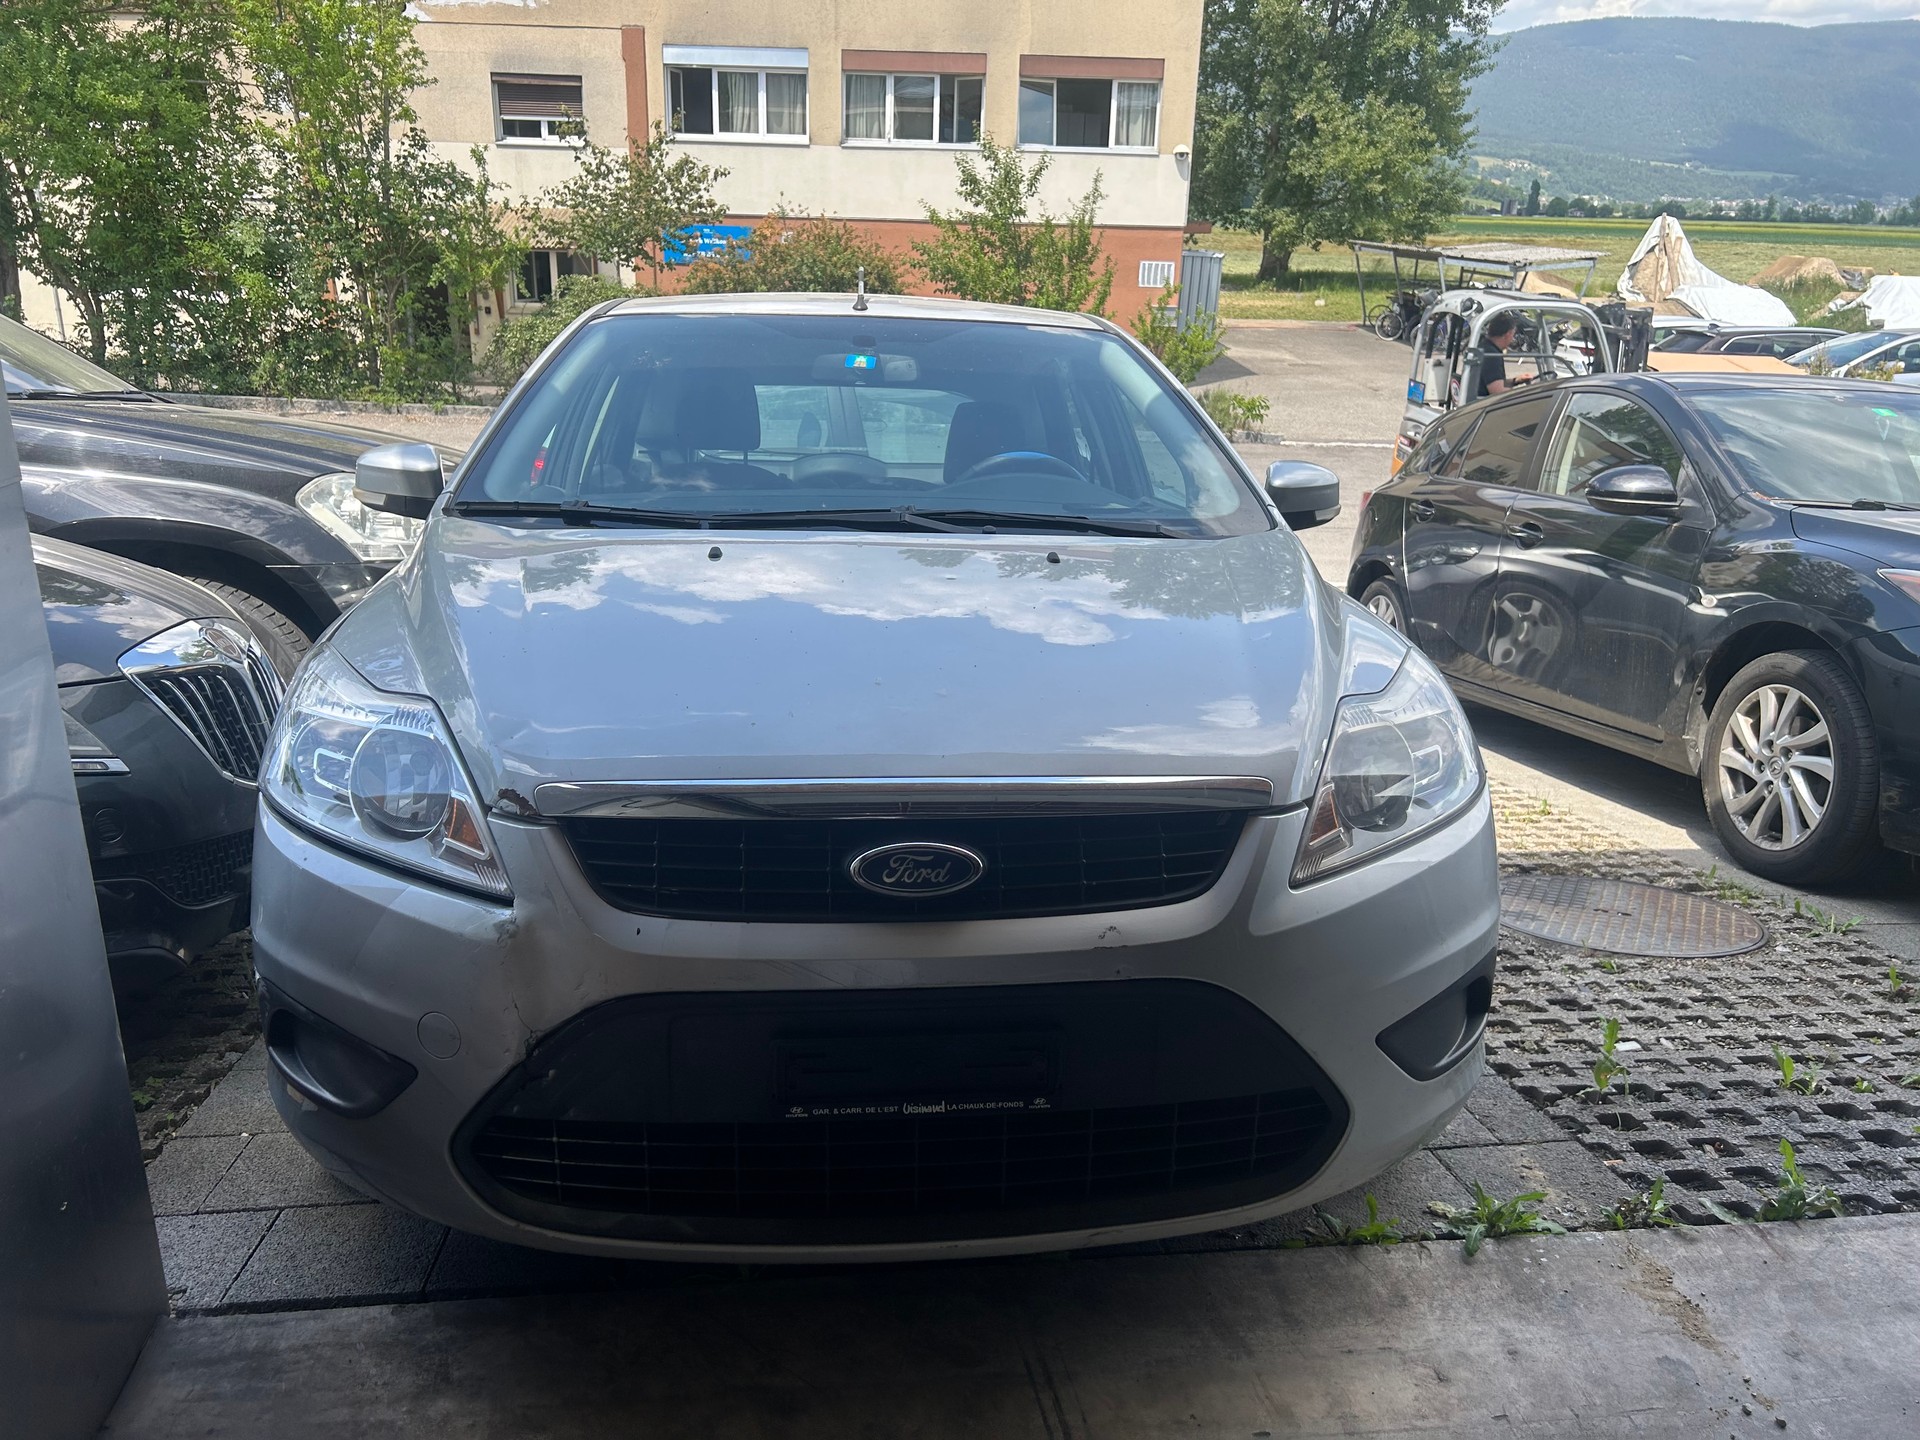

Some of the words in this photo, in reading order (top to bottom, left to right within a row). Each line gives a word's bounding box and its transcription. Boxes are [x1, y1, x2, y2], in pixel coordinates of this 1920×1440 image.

[882, 854, 952, 883] Ford
[947, 1103, 957, 1111] LA
[958, 1101, 1024, 1110] CHAUX-DE-FONDS
